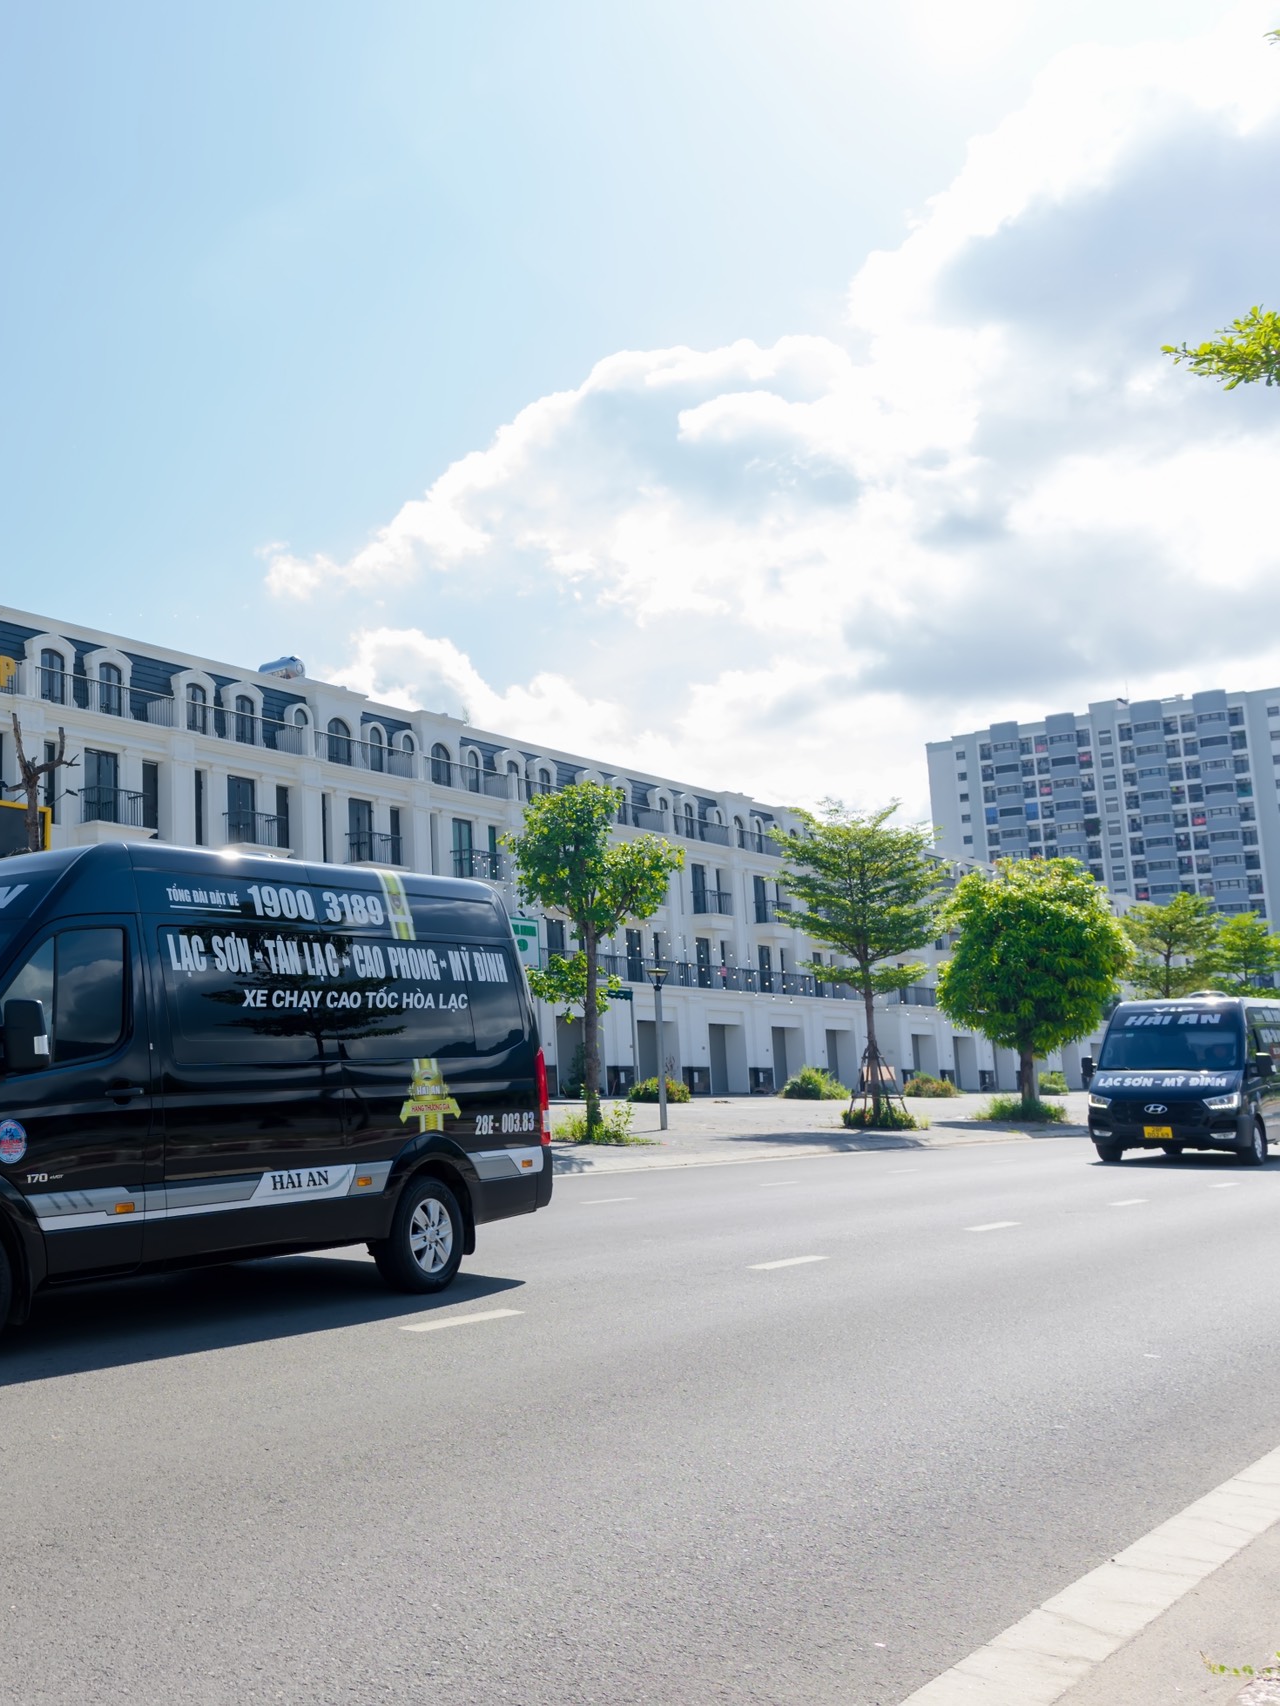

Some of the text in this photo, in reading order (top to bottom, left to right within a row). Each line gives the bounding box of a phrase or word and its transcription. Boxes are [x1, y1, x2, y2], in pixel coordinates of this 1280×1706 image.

[166, 883, 384, 926] TỔNG ĐÀI ĐẶT VÉ 1900 3189
[166, 932, 509, 983] LẠC SƠN TÂN LẠC CAO PHONG MỸ ĐÌNH
[242, 986, 468, 1013] XE CHẠY CAO TỐC HÒA LẠC
[1124, 1013, 1221, 1026] HẢI AN
[1098, 1078, 1121, 1088] LẠC
[1123, 1076, 1154, 1087] SƠN
[1161, 1076, 1187, 1087] MỸ
[1189, 1075, 1227, 1087] ĐÌNH
[475, 1115, 494, 1136] 28E
[501, 1111, 535, 1133] 003.83
[26, 1173, 48, 1184] 170
[271, 1170, 329, 1191] HẢI AN
